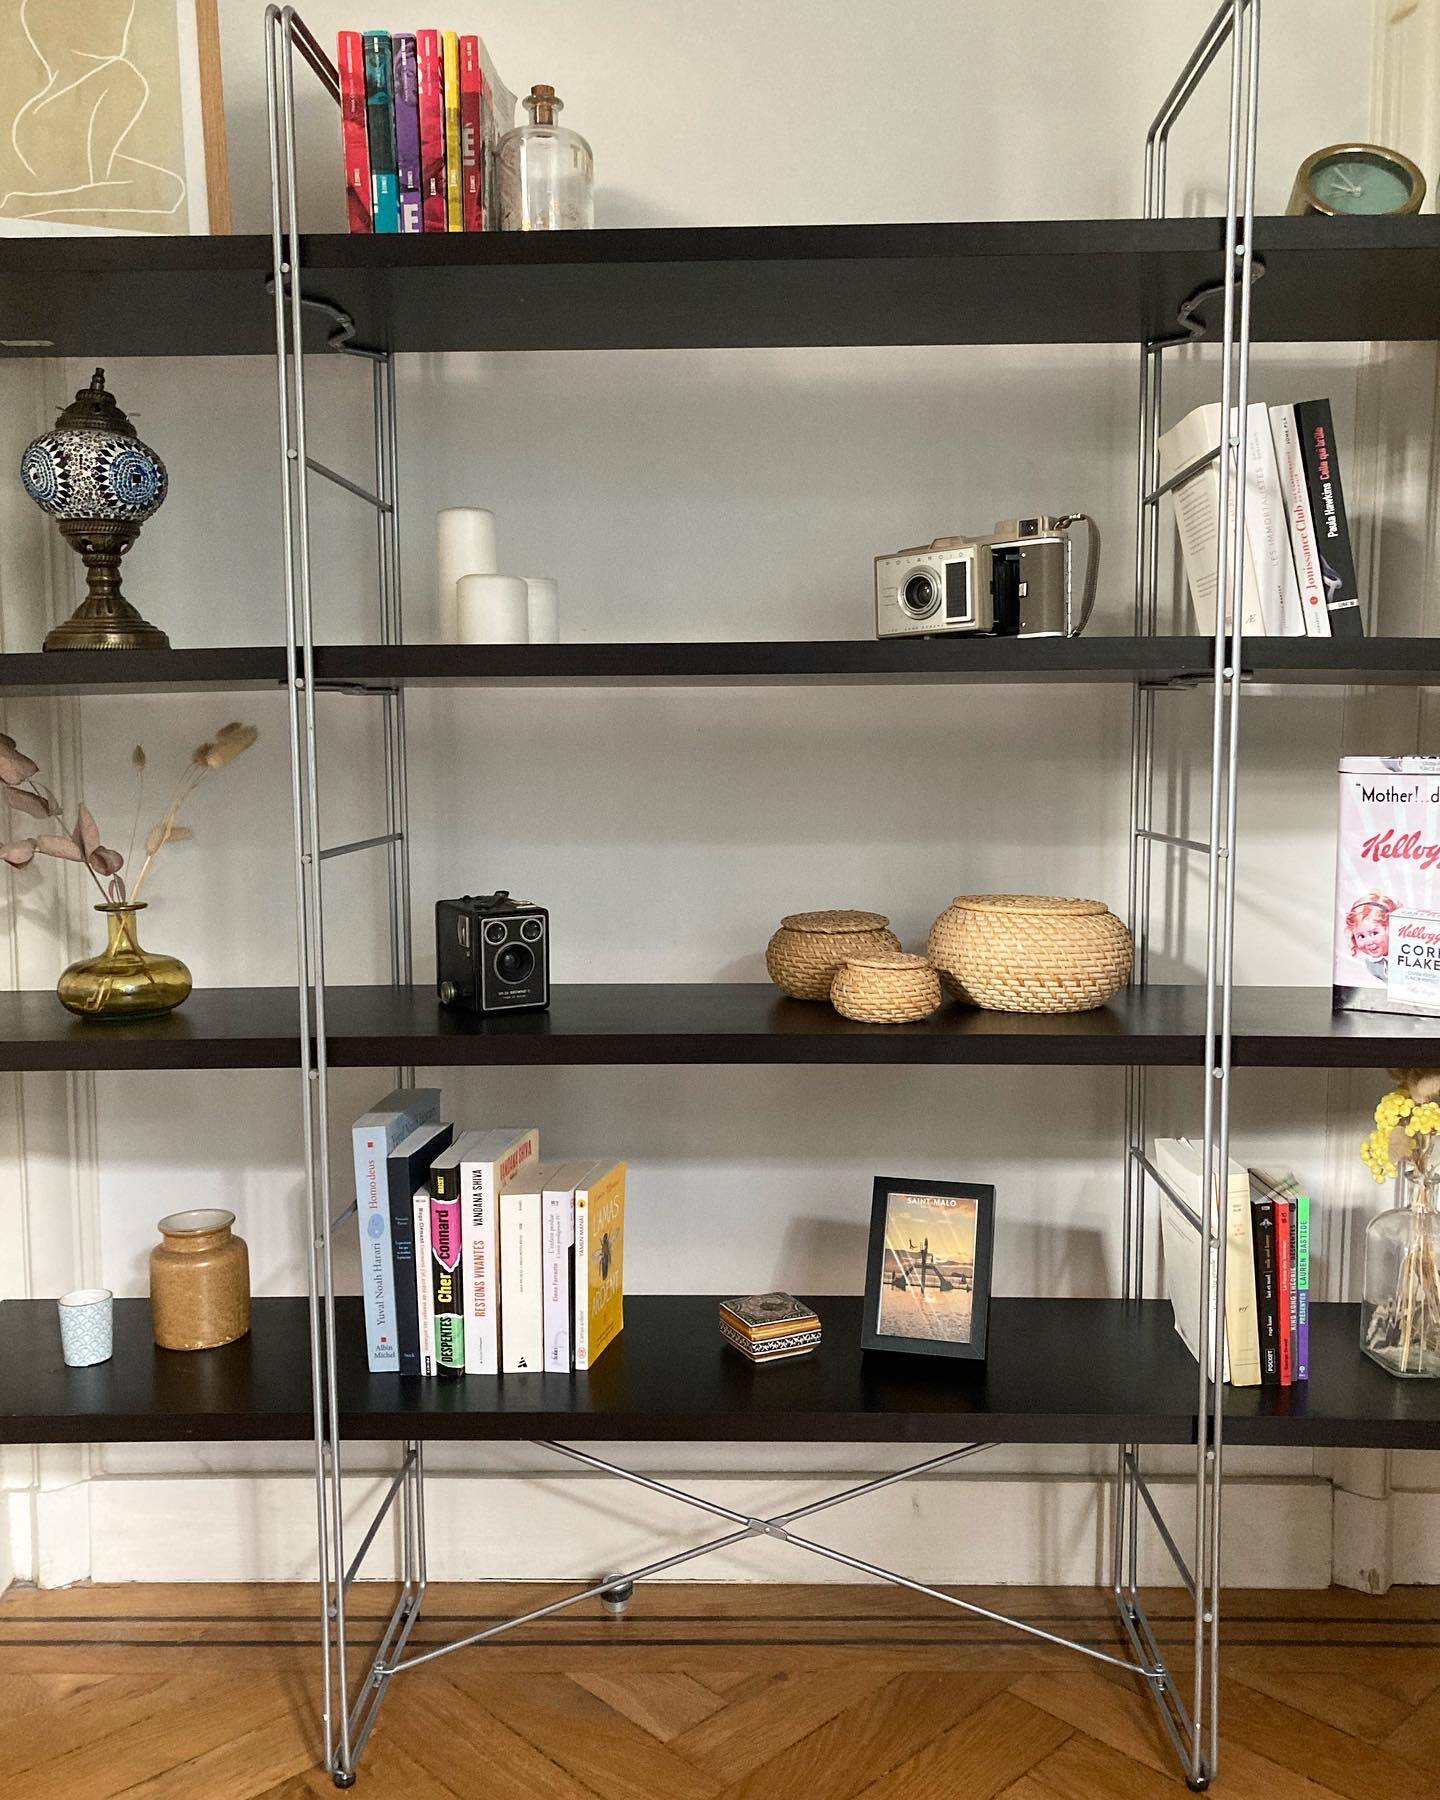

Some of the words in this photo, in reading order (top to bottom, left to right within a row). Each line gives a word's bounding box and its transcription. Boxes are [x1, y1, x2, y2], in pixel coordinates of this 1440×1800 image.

[1318, 448, 1329, 460] qui
[1321, 482, 1336, 516] Hawkins
[1294, 505, 1306, 532] Club
[1326, 515, 1339, 538] Paula
[1301, 533, 1317, 590] Jouissance
[1361, 828, 1440, 870] Kellog
[367, 1160, 376, 1180] deus
[472, 1169, 482, 1190] SHIVA
[369, 1181, 378, 1209] Homo
[473, 1193, 483, 1227] VANDANA
[436, 1210, 450, 1260] connard
[1299, 1220, 1307, 1253] BASTIDE
[372, 1243, 382, 1272] Harari
[473, 1240, 485, 1278] VIVANTES
[1299, 1258, 1307, 1286] LAUREN
[374, 1275, 384, 1299] Noah
[437, 1273, 452, 1303] Cher
[474, 1281, 485, 1317] RESTONS
[376, 1302, 386, 1326] Yuval
[440, 1317, 452, 1363] DESPENTES
[374, 1351, 396, 1359] Michel
